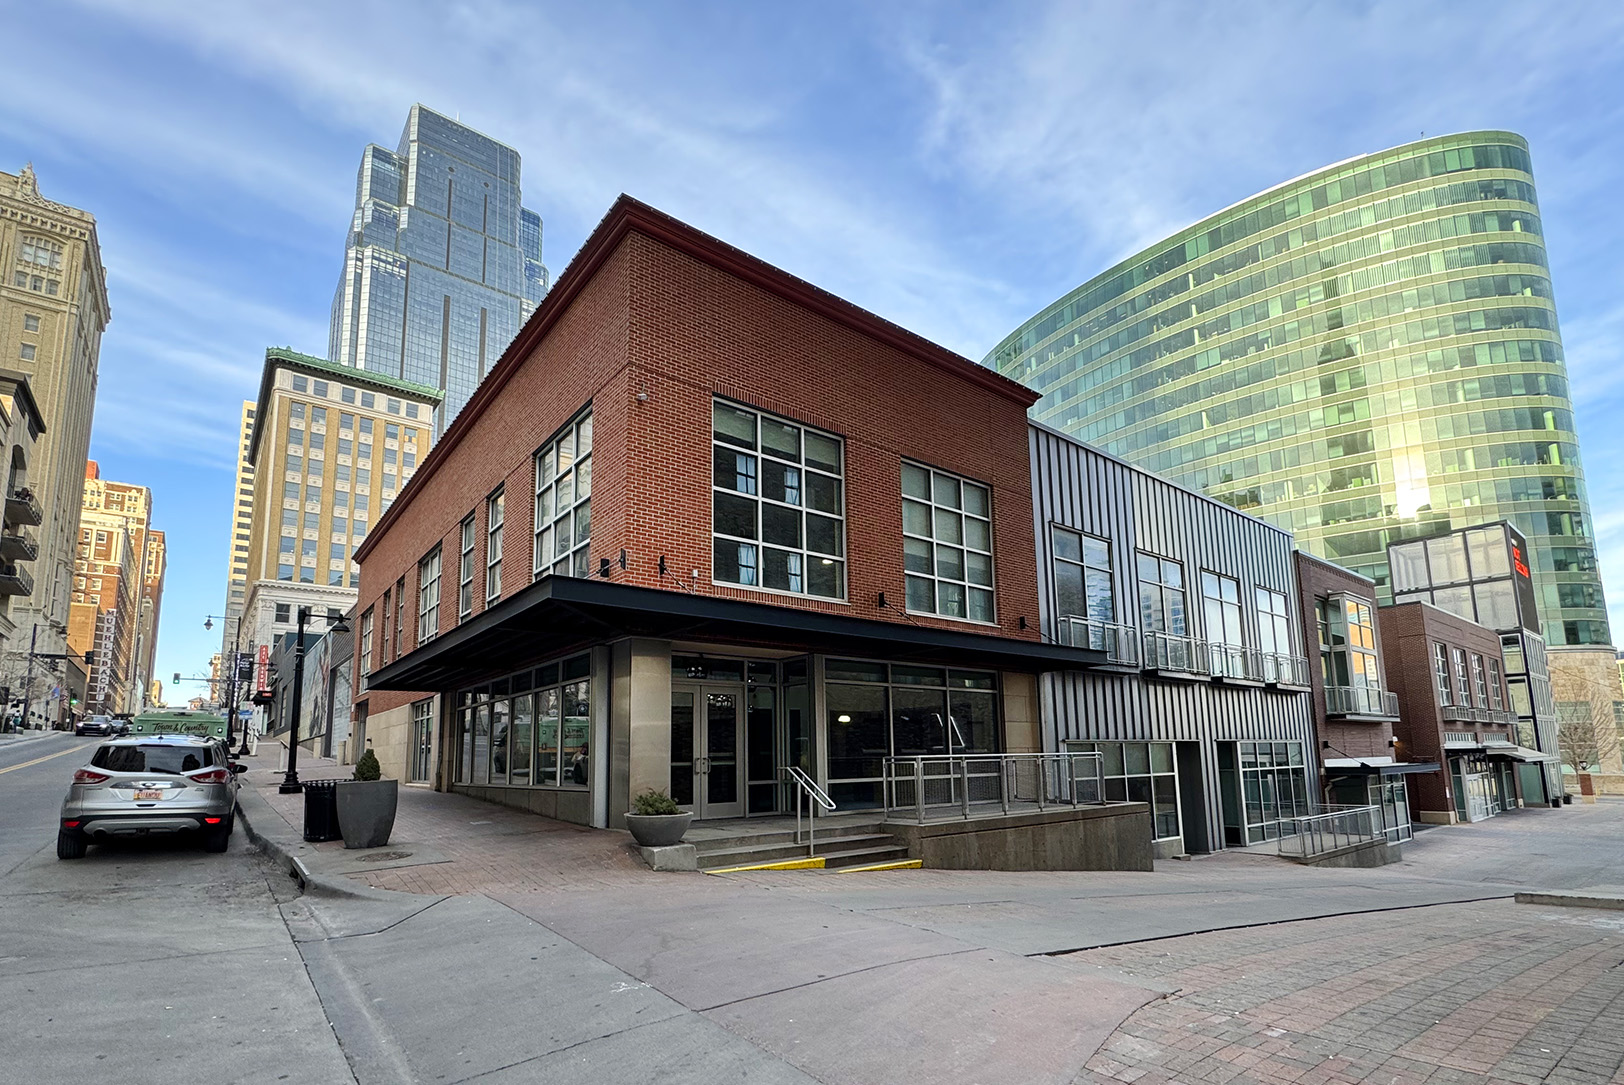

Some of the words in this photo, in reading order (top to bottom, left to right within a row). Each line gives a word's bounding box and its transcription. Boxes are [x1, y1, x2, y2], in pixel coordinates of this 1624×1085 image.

[98, 610, 116, 692] MUEHLEBACH
[152, 722, 173, 732] Town
[173, 723, 179, 732] &
[179, 722, 209, 734] Country
